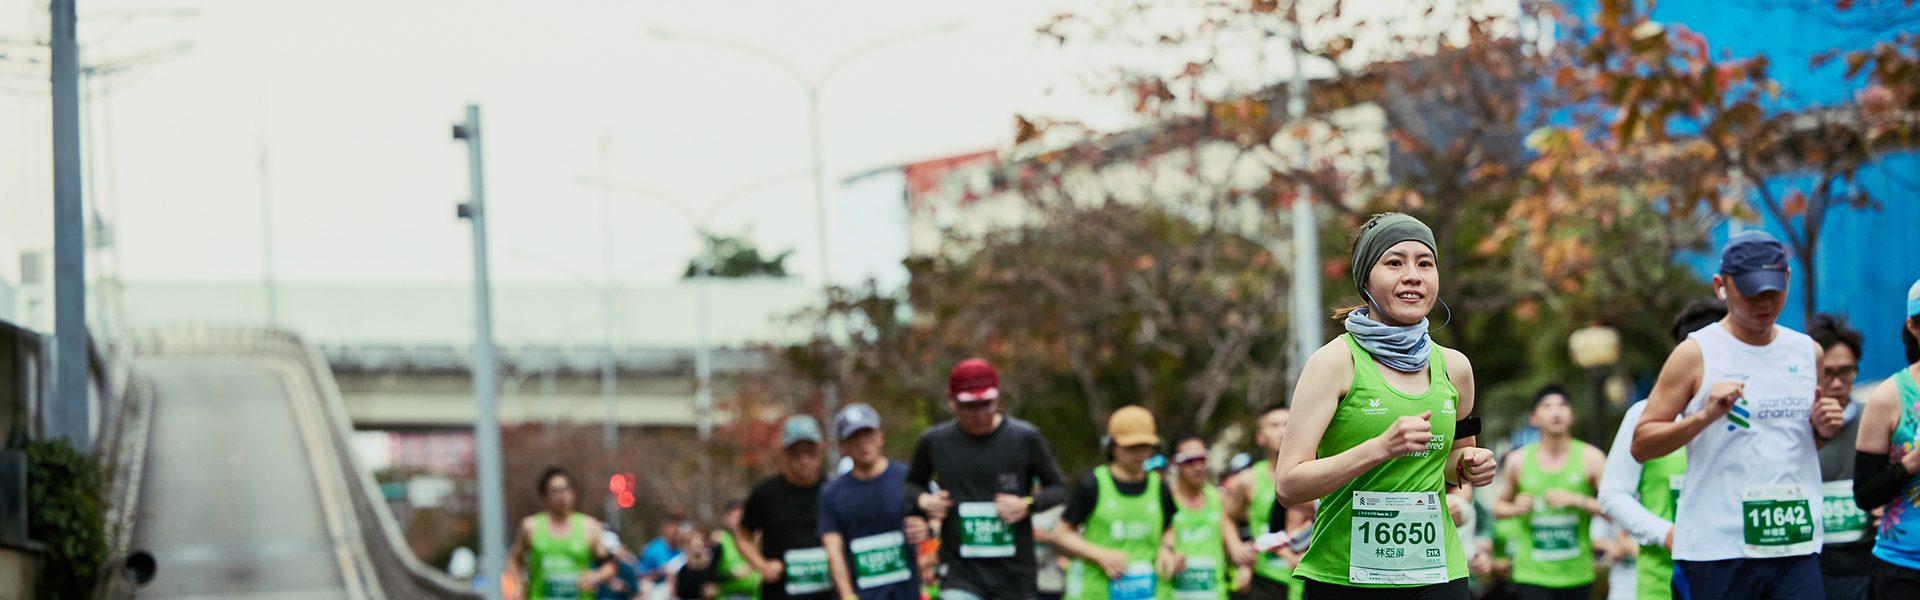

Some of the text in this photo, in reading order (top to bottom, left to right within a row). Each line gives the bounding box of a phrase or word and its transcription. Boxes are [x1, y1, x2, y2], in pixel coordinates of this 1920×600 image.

[1758, 409, 1809, 419] chartere
[1748, 506, 1808, 527] 11642
[1358, 521, 1436, 545] 16650
[1427, 549, 1440, 557] 21K
